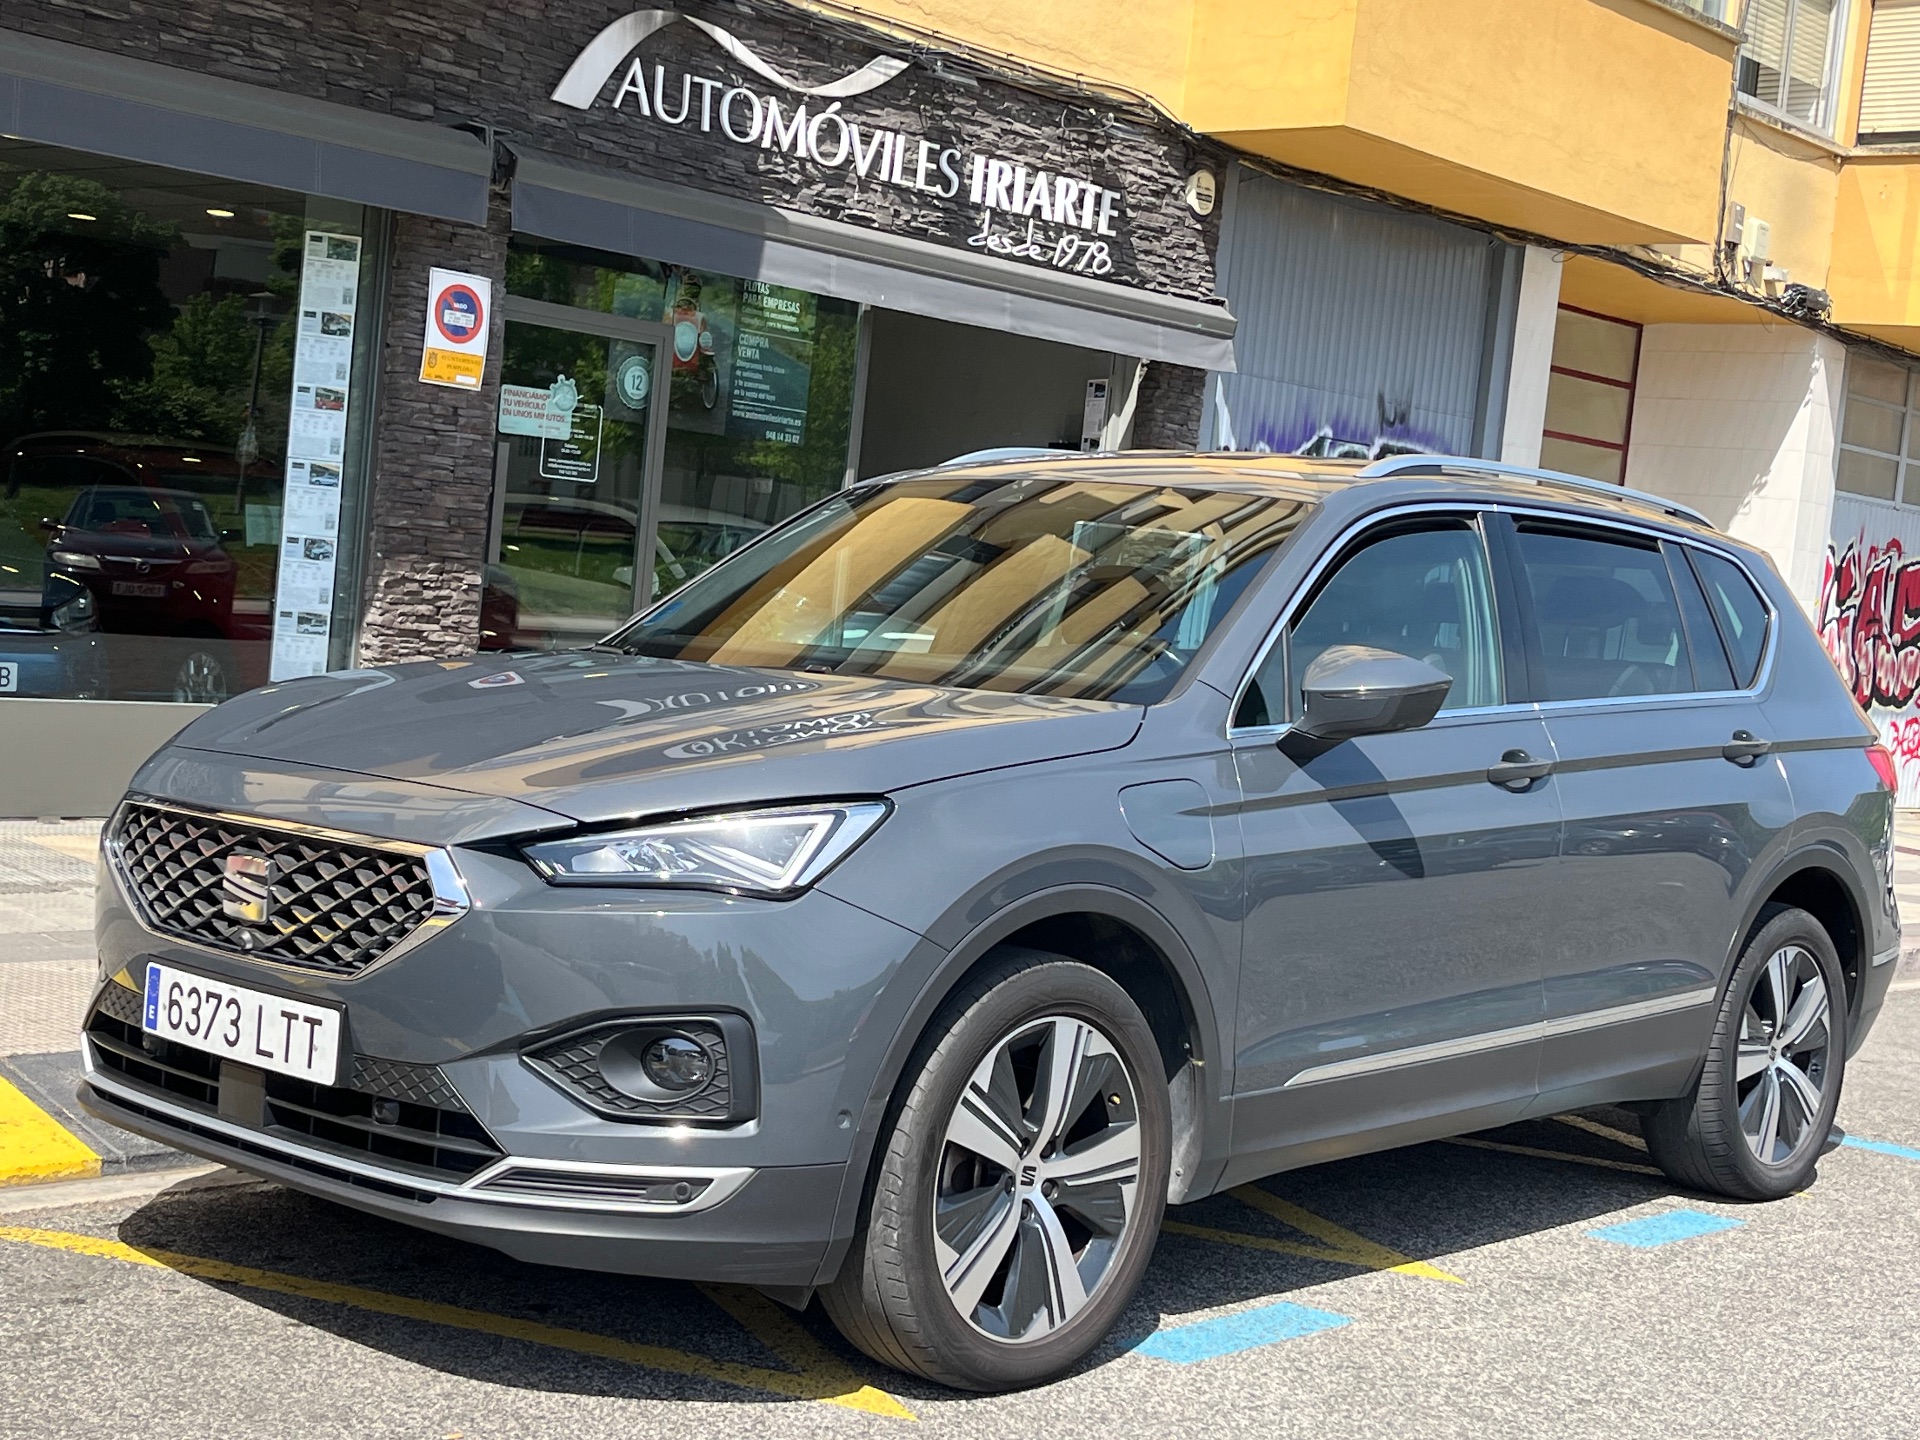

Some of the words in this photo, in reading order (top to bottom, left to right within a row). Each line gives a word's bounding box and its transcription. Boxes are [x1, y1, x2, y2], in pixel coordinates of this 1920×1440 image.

[611, 57, 961, 198] AUTOMÓVILES
[970, 155, 1121, 237] IRIARTE
[967, 208, 1048, 262] desde
[1052, 235, 1112, 275] 1978
[744, 280, 770, 295] FLOTAS
[743, 292, 762, 307] PARA
[763, 296, 800, 314] EMPRESAS
[738, 333, 769, 349] COMPRA
[737, 345, 760, 360] VENTA
[631, 374, 643, 391] 12
[503, 398, 513, 407] TU
[513, 399, 547, 411] VEHÍCULO
[502, 407, 512, 417] EN
[512, 409, 533, 419] UNOS
[533, 411, 566, 423] MINUTOS
[148, 1004, 156, 1020] E
[167, 981, 242, 1048] 6373
[255, 1004, 323, 1069] LTT
